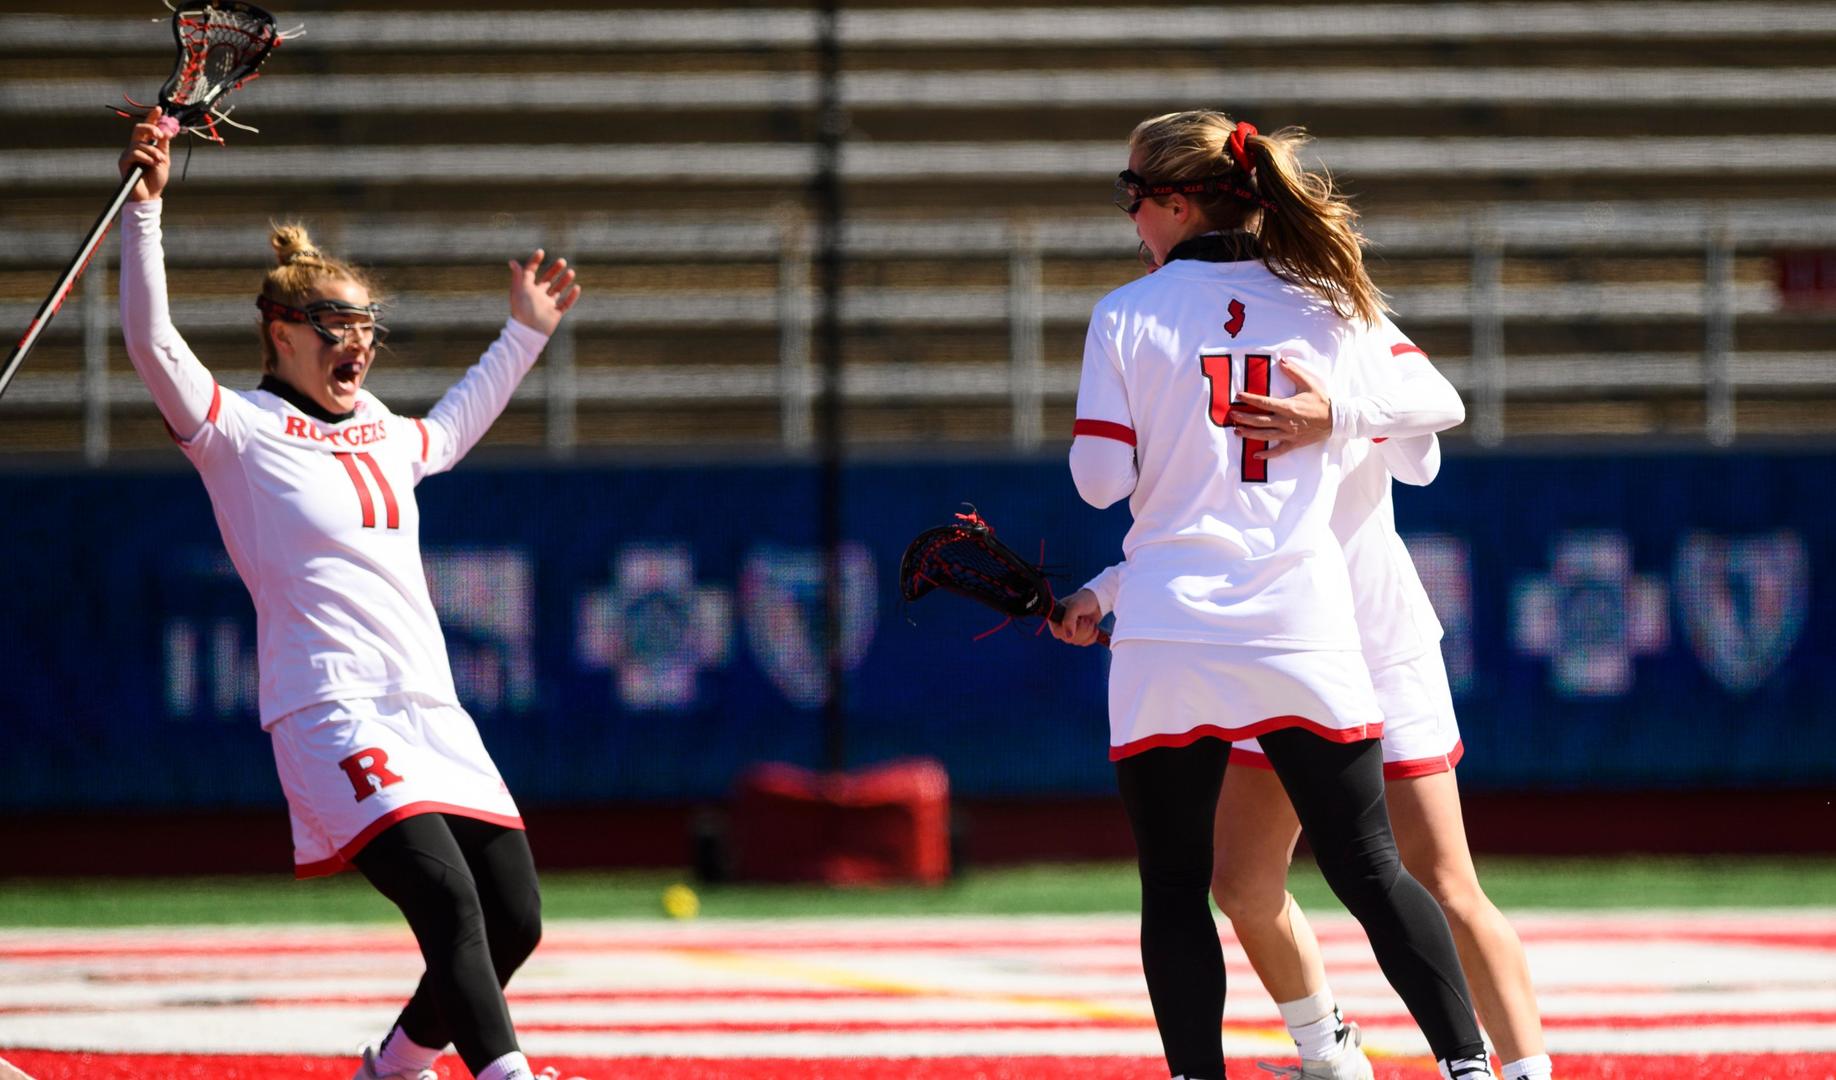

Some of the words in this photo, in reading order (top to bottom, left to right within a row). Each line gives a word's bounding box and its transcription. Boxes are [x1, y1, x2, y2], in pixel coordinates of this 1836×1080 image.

[284, 416, 386, 447] RUTGERS
[1200, 354, 1272, 483] 4
[331, 451, 400, 529] 11
[338, 747, 405, 803] R
